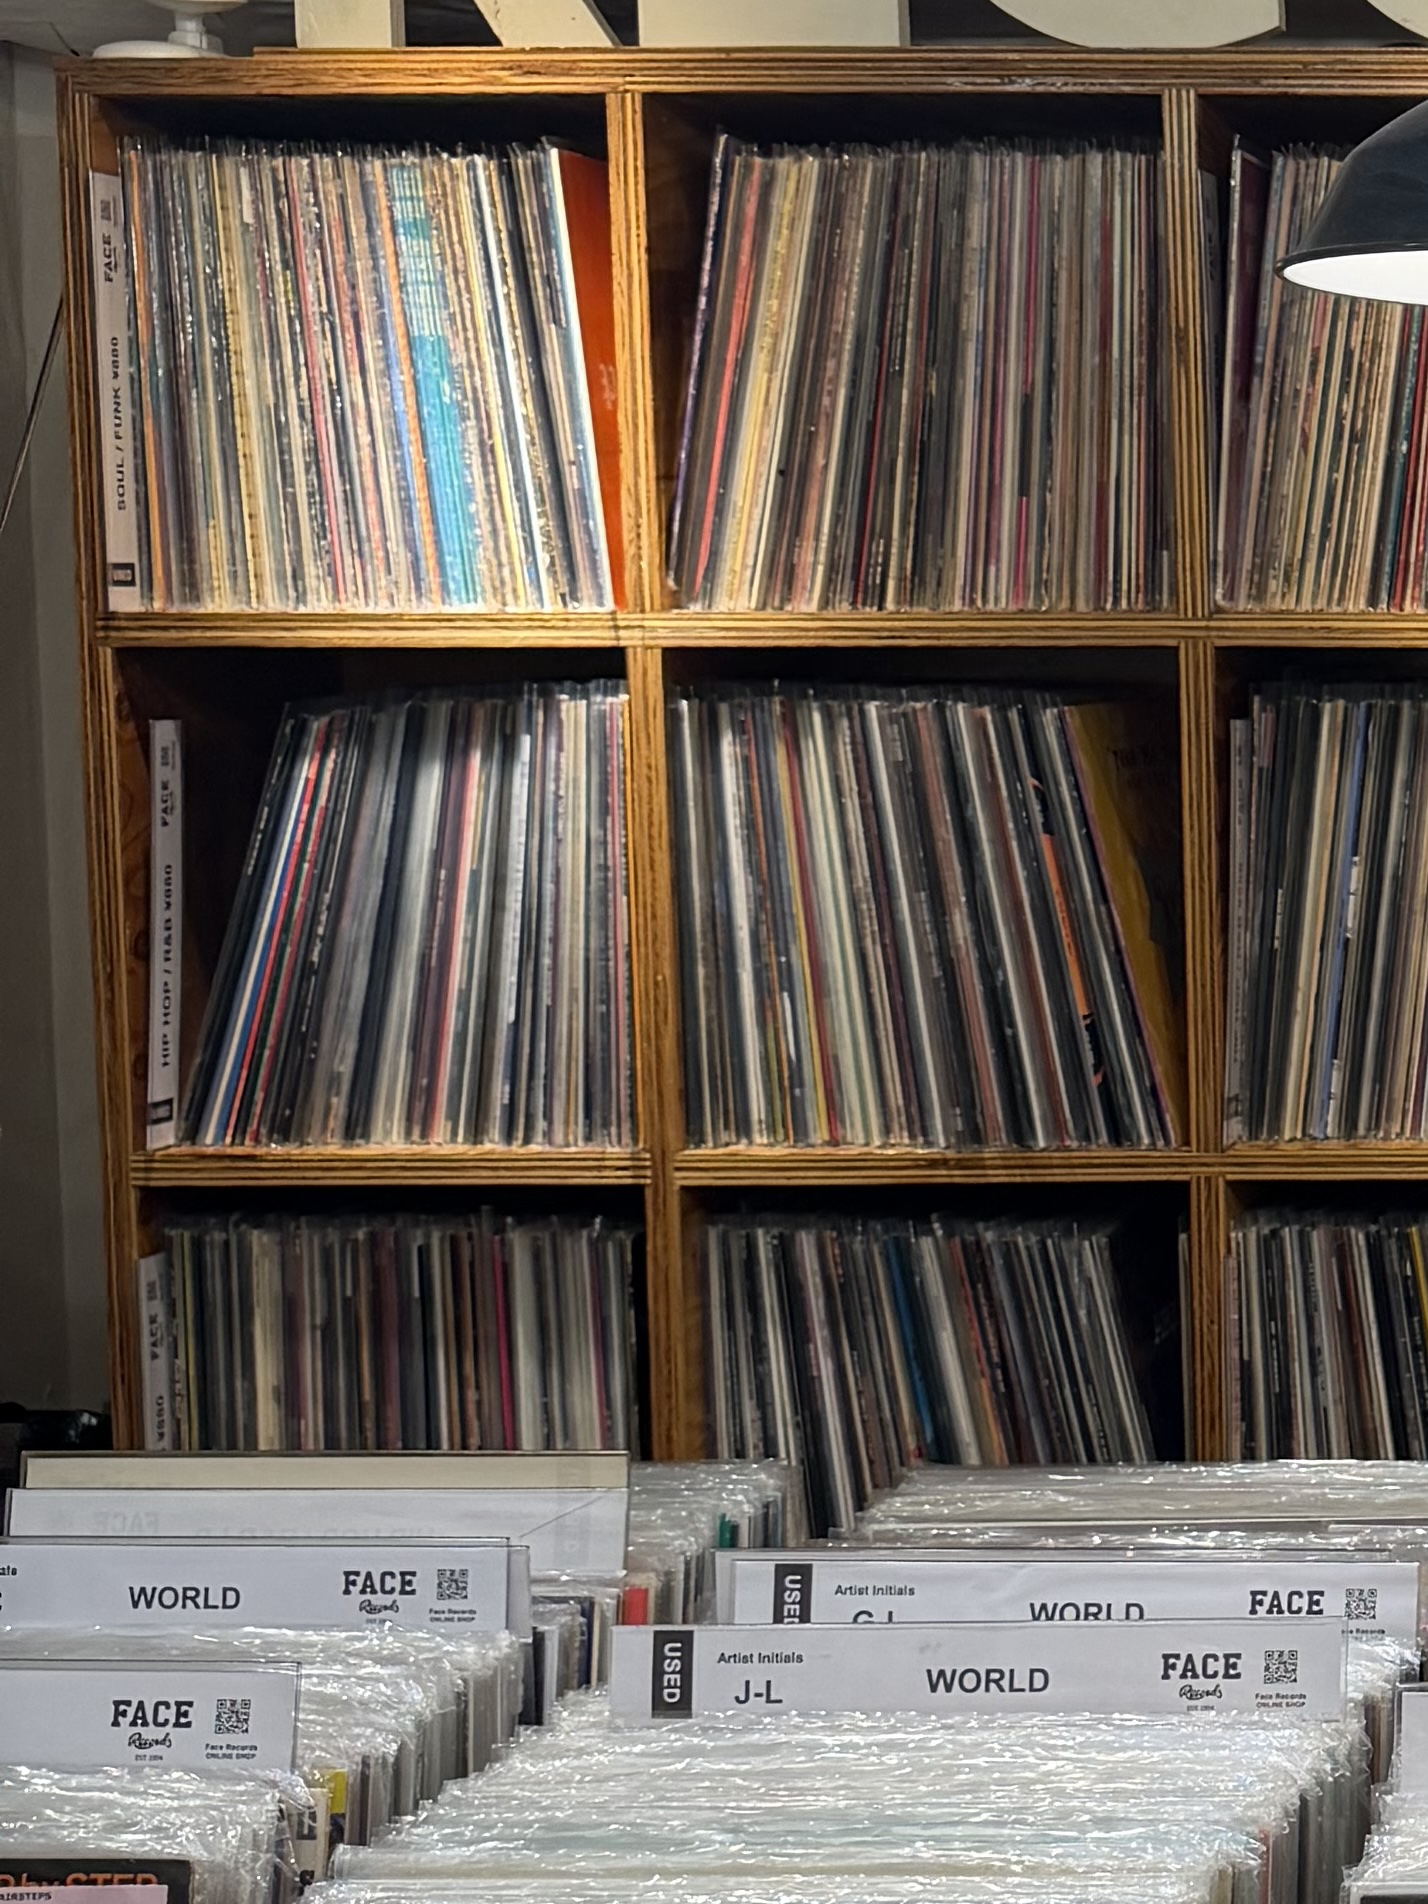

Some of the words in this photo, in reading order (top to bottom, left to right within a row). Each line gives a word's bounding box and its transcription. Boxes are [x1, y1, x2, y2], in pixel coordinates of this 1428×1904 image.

[113, 385, 123, 441] FUNK
[117, 464, 126, 512] SOUL
[342, 1570, 418, 1596] FACE
[835, 1584, 869, 1596] Artist
[872, 1584, 915, 1597] Initials
[128, 1585, 241, 1611] WORLD
[1249, 1590, 1325, 1615] FACE
[1029, 1602, 1145, 1621] WORLD
[717, 1652, 754, 1665] Artist
[757, 1652, 804, 1665] Initials
[1161, 1652, 1242, 1681] FACE
[662, 1642, 683, 1703] USED
[926, 1668, 1049, 1694] WORLD
[734, 1679, 783, 1705] J-L
[110, 1700, 194, 1729] FACE
